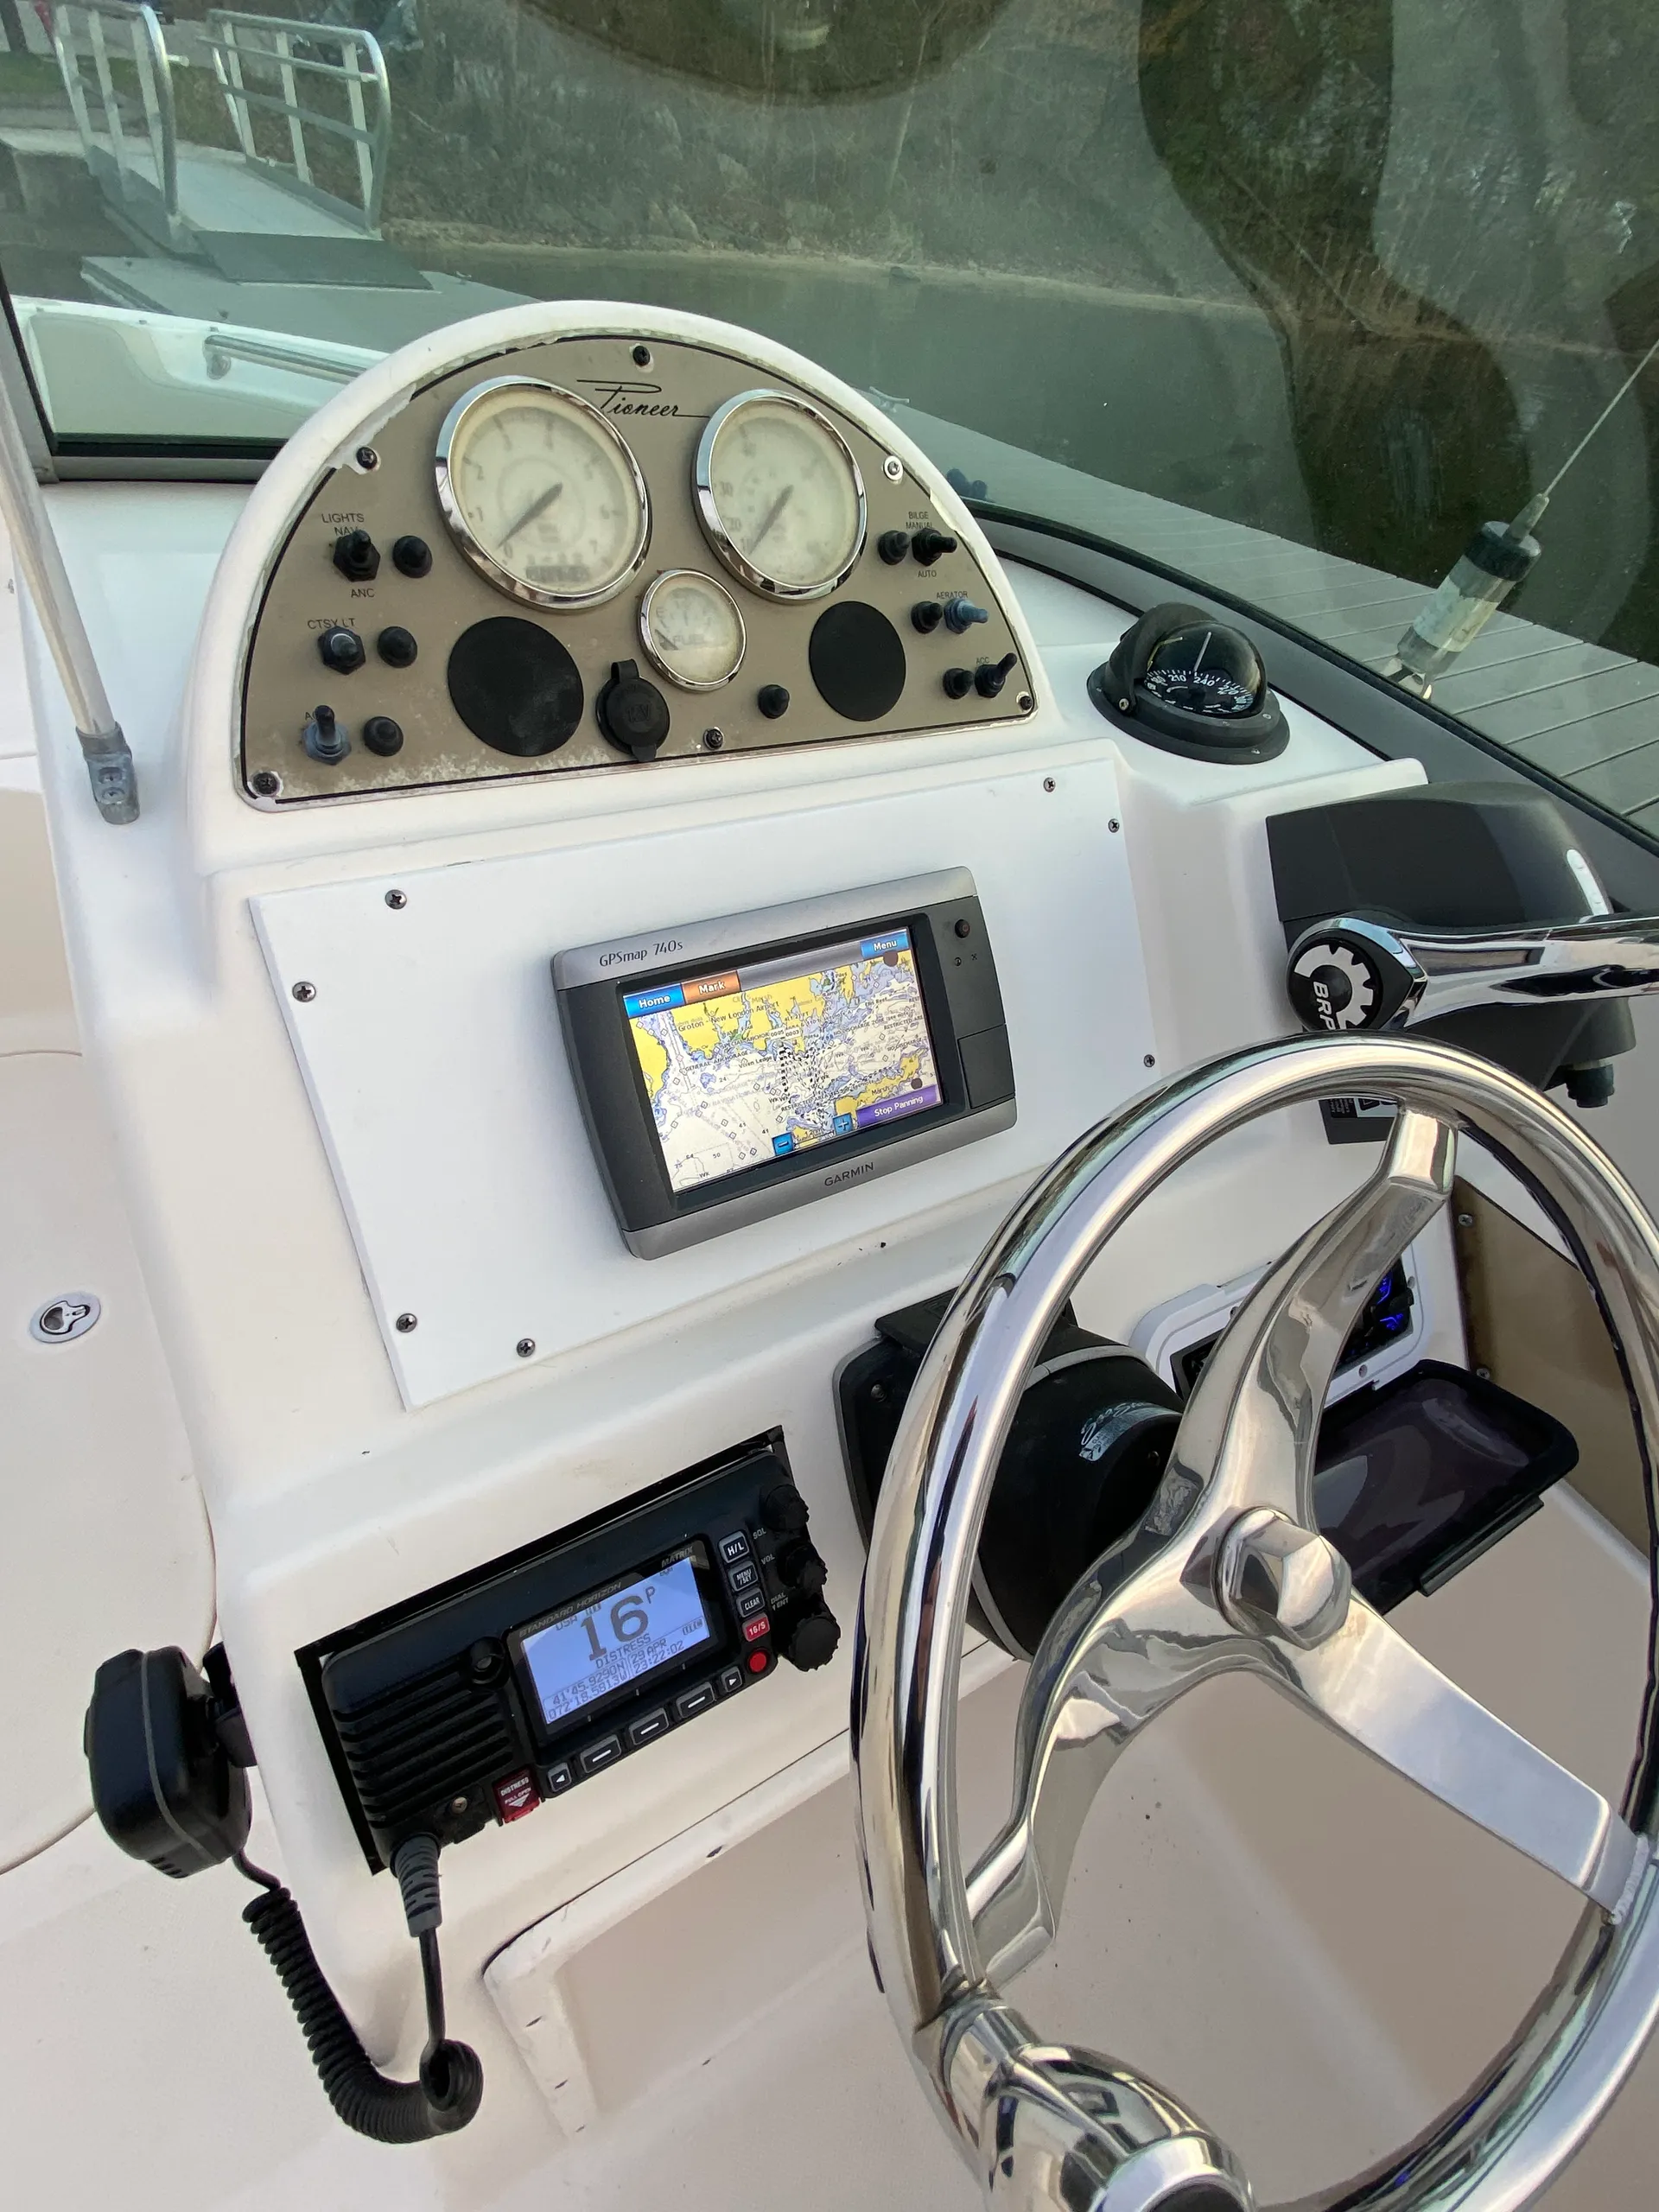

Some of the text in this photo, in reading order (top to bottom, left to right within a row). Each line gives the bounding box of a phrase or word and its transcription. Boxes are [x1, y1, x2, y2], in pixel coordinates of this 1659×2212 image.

[577, 379, 709, 418] Pioneer
[321, 513, 365, 524] LIGHTS
[906, 521, 932, 530] MANUAL
[918, 569, 937, 578] AUTO
[351, 588, 375, 598] ANC
[936, 590, 969, 600] AERATOR
[1193, 677, 1216, 687] 240
[873, 938, 897, 951] Menu
[599, 939, 683, 967] GPSmap 740s
[638, 979, 726, 1009] Home Mark
[1313, 981, 1337, 1030] BRP
[677, 1020, 704, 1033] Groton
[710, 1014, 726, 1024] New
[728, 1007, 753, 1019] London
[754, 1000, 779, 1013] Airport
[685, 1060, 710, 1071] GENERAL
[755, 1055, 772, 1065] Ledge
[870, 1084, 890, 1096] Marsh
[874, 1094, 924, 1117] Stop Panning
[823, 1161, 874, 1186] GARMIN
[727, 1541, 745, 1556] H/L
[661, 1546, 693, 1568] MATRIX
[760, 1554, 775, 1565] VOL
[736, 1568, 752, 1580] MENU
[744, 1597, 760, 1611] CLEAR
[770, 1592, 786, 1605] DIAL
[518, 1605, 574, 1638] STANDARD
[576, 1581, 621, 1609] HORIZON
[580, 1595, 648, 1661] 16
[645, 1586, 656, 1605] P
[748, 1621, 766, 1636] 16/S
[595, 1633, 652, 1669] DISTRESS
[646, 1637, 667, 1656] APR
[633, 1640, 684, 1673] 23:22:02
[500, 1777, 530, 1796] DISTRESS
